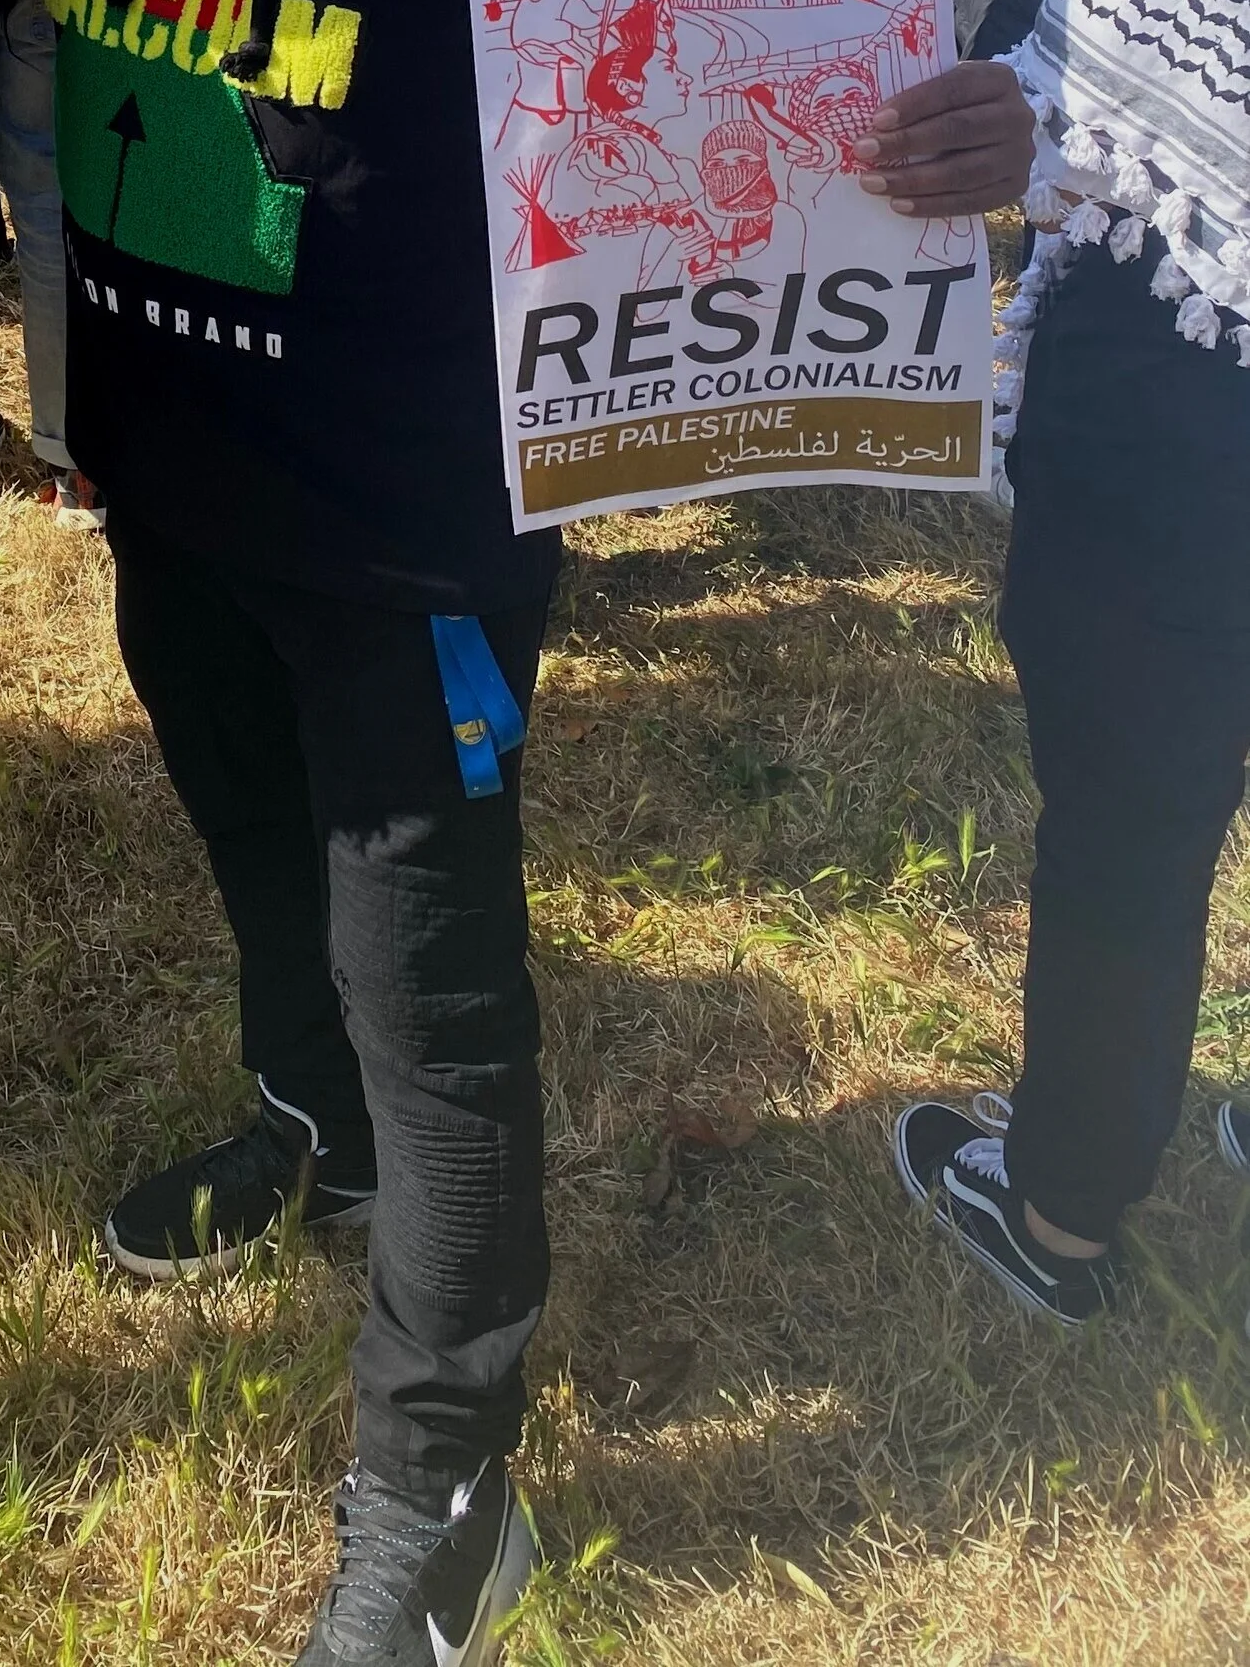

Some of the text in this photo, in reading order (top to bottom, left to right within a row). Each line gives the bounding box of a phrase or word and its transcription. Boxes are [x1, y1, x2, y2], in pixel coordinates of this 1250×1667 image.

[145, 299, 282, 359] BRAND
[516, 262, 976, 393] RESIST
[516, 363, 962, 429] SETTLER COLONIALISM
[524, 407, 797, 470] FREE PALESTINE
[703, 432, 840, 475] لفلسطين
